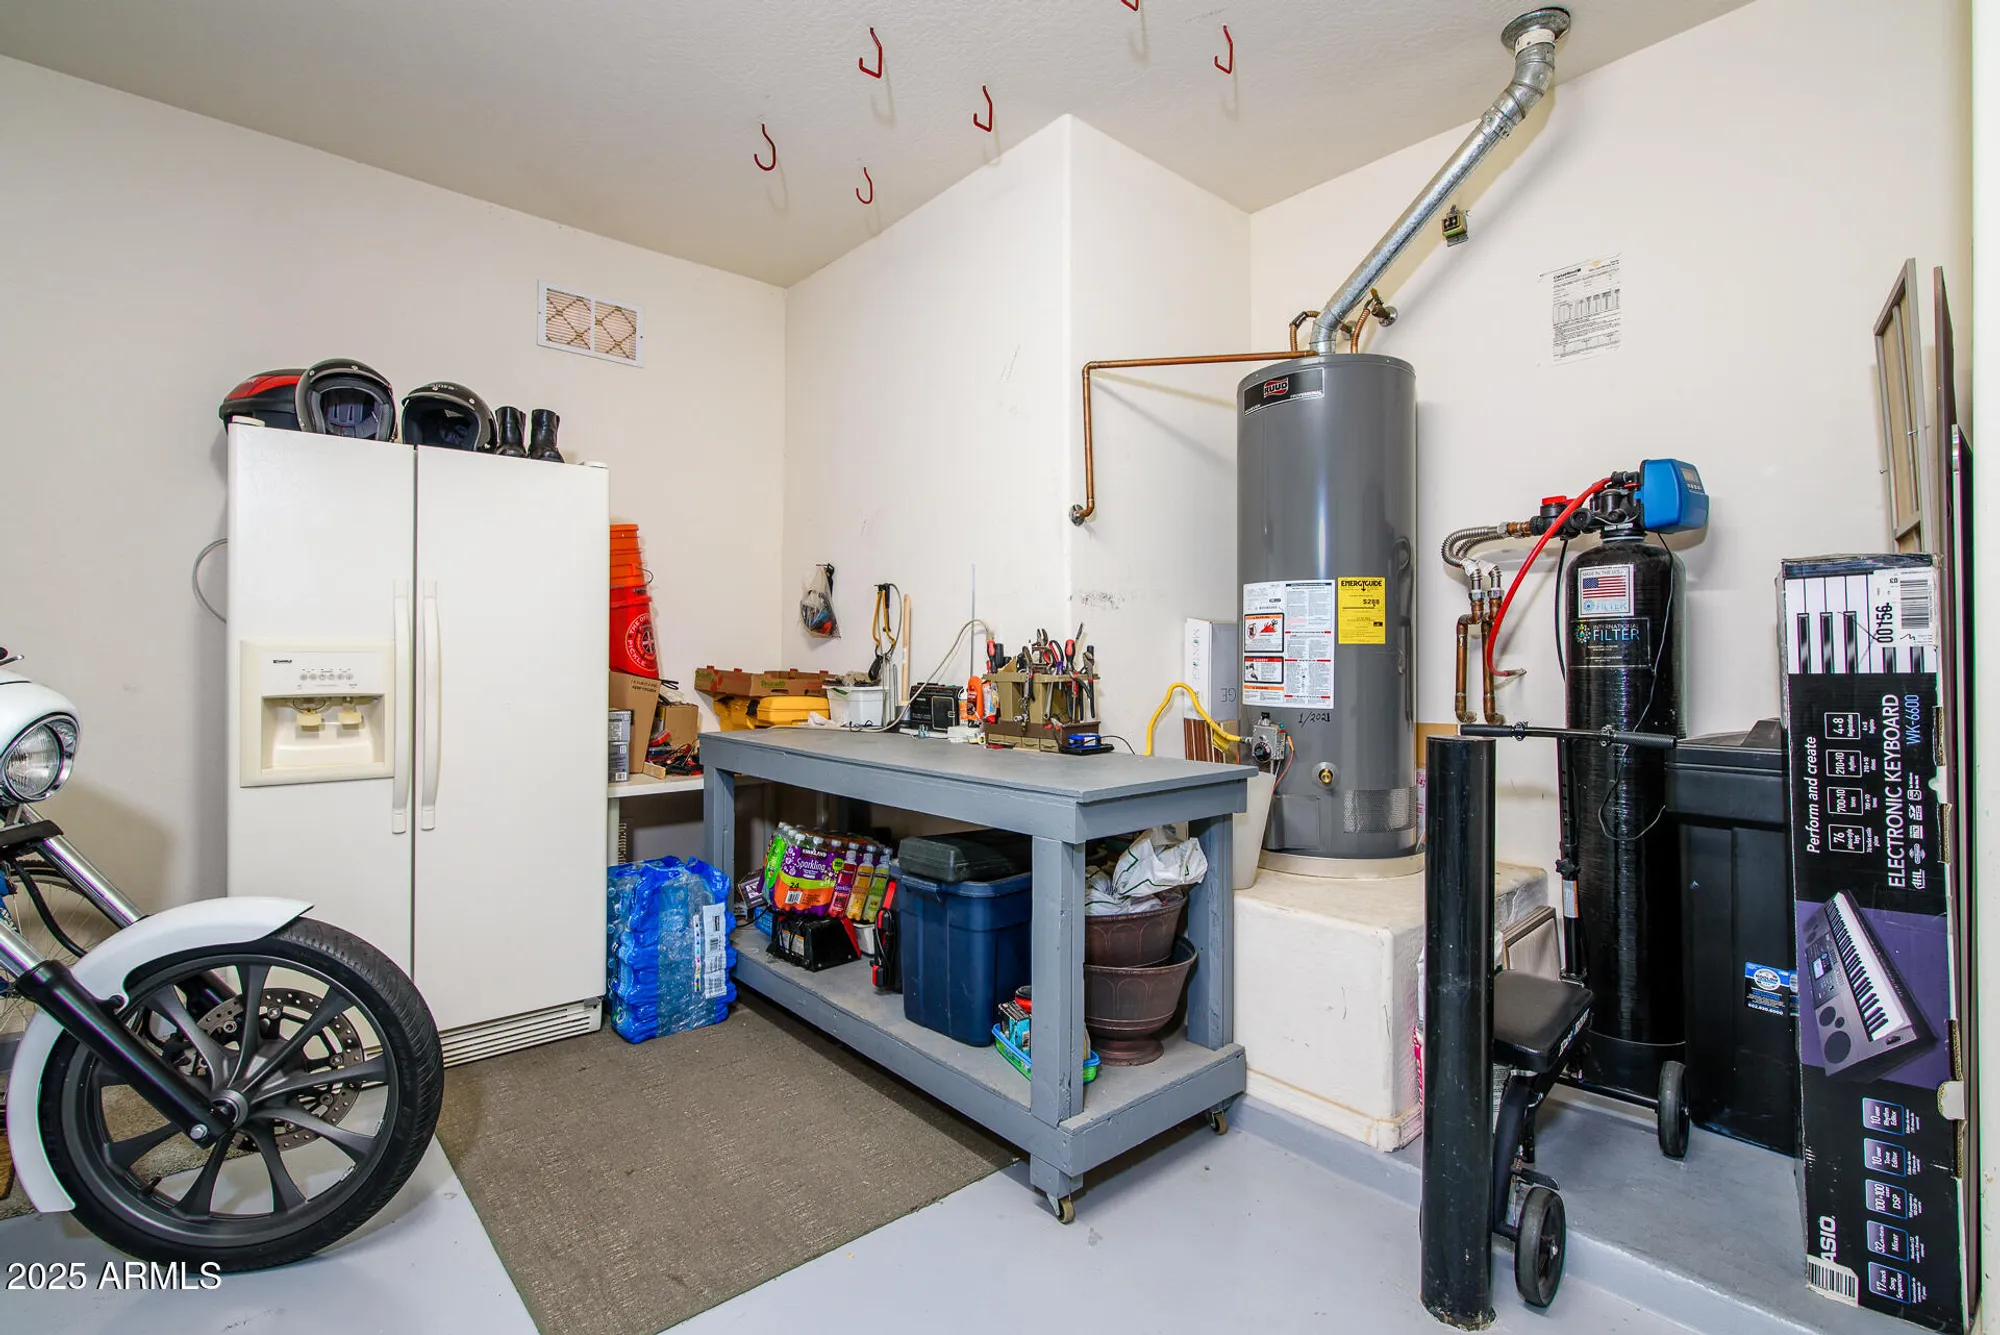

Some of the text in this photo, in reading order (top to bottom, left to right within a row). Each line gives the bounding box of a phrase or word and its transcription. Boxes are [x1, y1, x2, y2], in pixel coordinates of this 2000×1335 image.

[1264, 382, 1287, 393] RUUD
[629, 621, 640, 634] THE
[1875, 605, 1893, 643] 00156
[1593, 629, 1640, 641] FILTER
[627, 639, 646, 667] PICKLE
[1298, 709, 1331, 727] 1/2021
[1904, 694, 1921, 745] WK-6600
[1835, 752, 1845, 775] 210+10
[1803, 736, 1820, 853] Perform and create
[1882, 694, 1906, 887] ELECTRONIC KEYBOARD
[1836, 789, 1847, 812] 700+10
[1833, 832, 1845, 843] 76
[802, 848, 827, 857] KIRKLAND
[795, 858, 826, 873] Sparkling
[1870, 1115, 1881, 1124] 10
[1871, 1156, 1882, 1165] 10
[1874, 1183, 1886, 1212] 100+100
[1892, 1194, 1901, 1210] DSP
[1819, 1215, 1837, 1262] ASIO
[1889, 1277, 1897, 1290] Song
[1896, 1273, 1904, 1299] Sequencer
